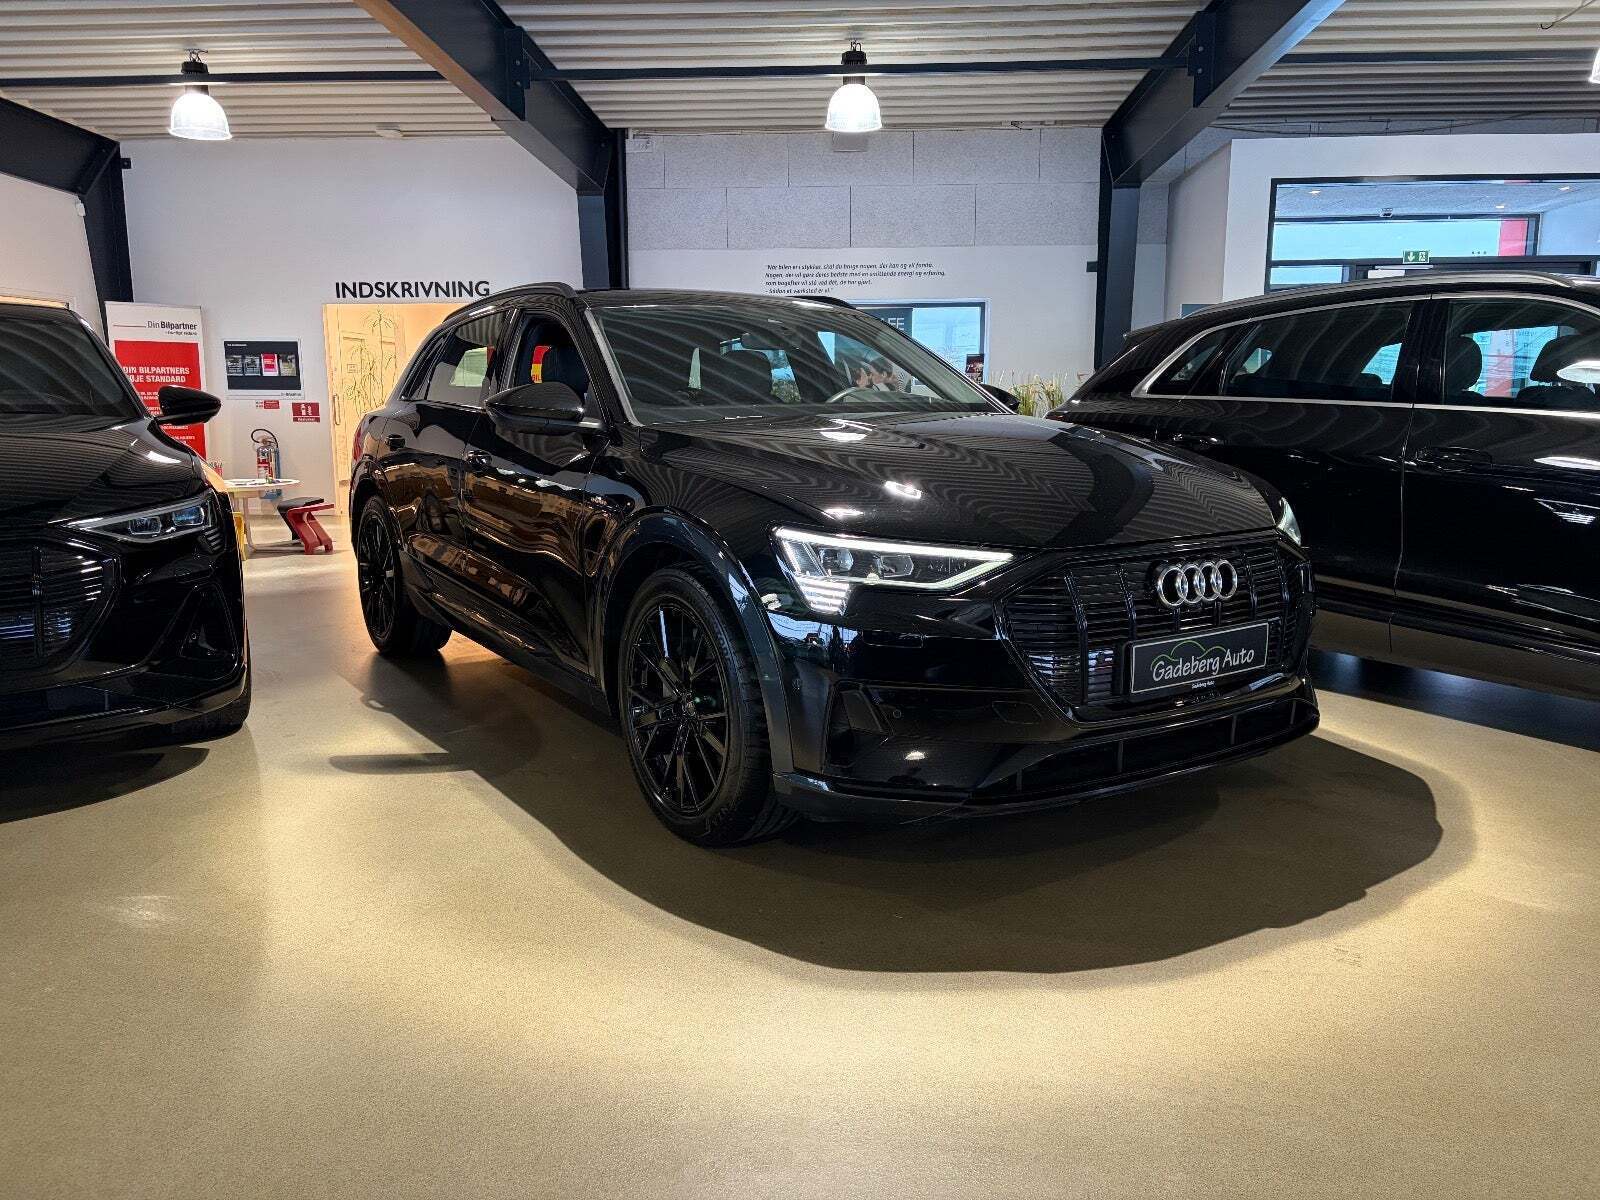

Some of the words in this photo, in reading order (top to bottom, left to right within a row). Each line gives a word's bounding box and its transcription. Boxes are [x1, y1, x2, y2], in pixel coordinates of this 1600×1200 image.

[335, 280, 490, 299] INDSKRIVNING
[147, 320, 160, 329] Din
[160, 321, 197, 330] Bilpartner
[122, 366, 137, 374] DIN
[140, 366, 190, 375] BILPARTNERS
[145, 375, 186, 383] STANDARD
[1152, 656, 1220, 681] Gadeberg
[1222, 648, 1255, 668] Auto
